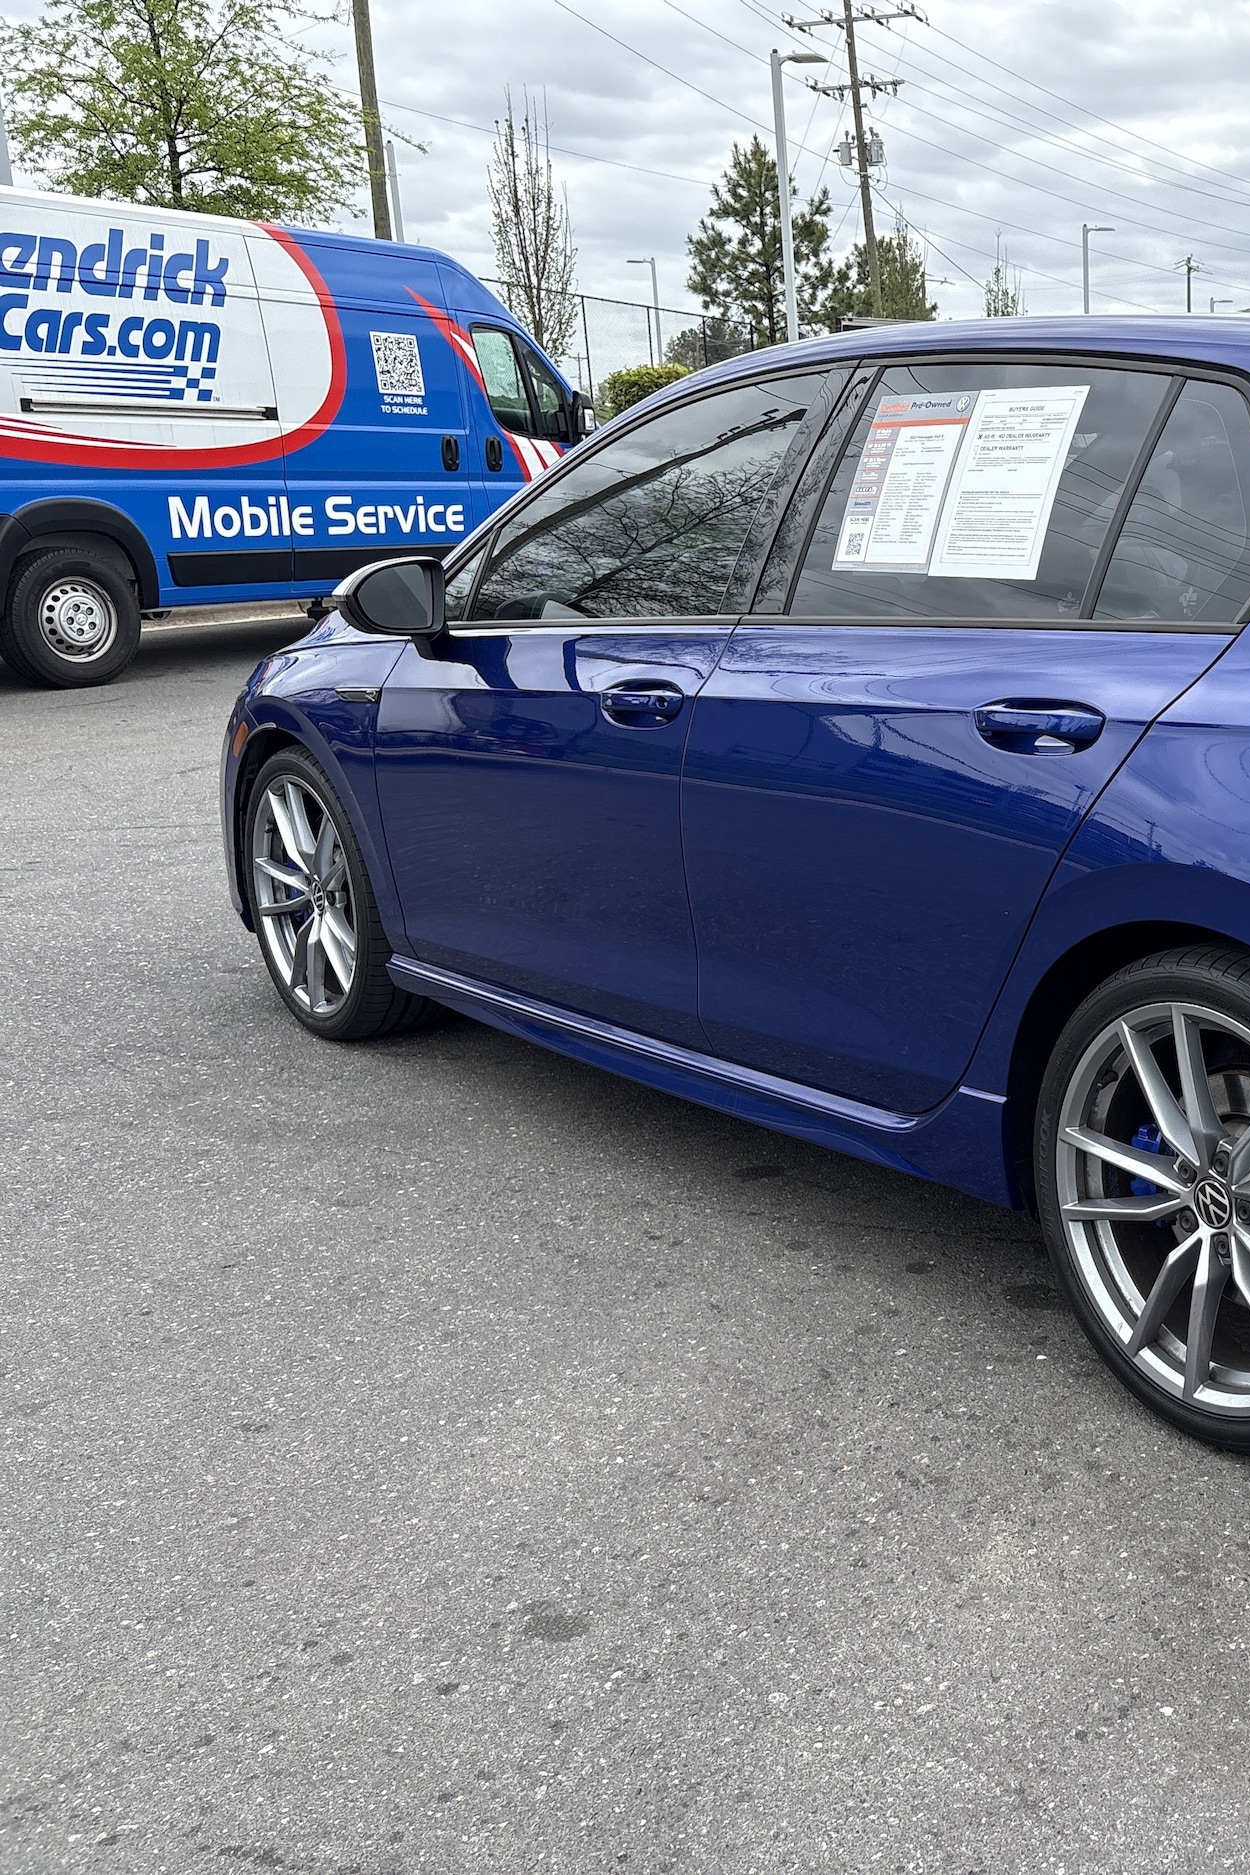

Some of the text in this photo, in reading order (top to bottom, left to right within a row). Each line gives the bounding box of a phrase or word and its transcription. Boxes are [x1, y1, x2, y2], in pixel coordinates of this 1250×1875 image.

[0, 293, 221, 363] Cars.com
[383, 395, 423, 404] SCAN HERE
[910, 399, 953, 410] Pre-Owned
[381, 405, 428, 415] TO SCHEDULE
[168, 496, 465, 539] Mobile Service
